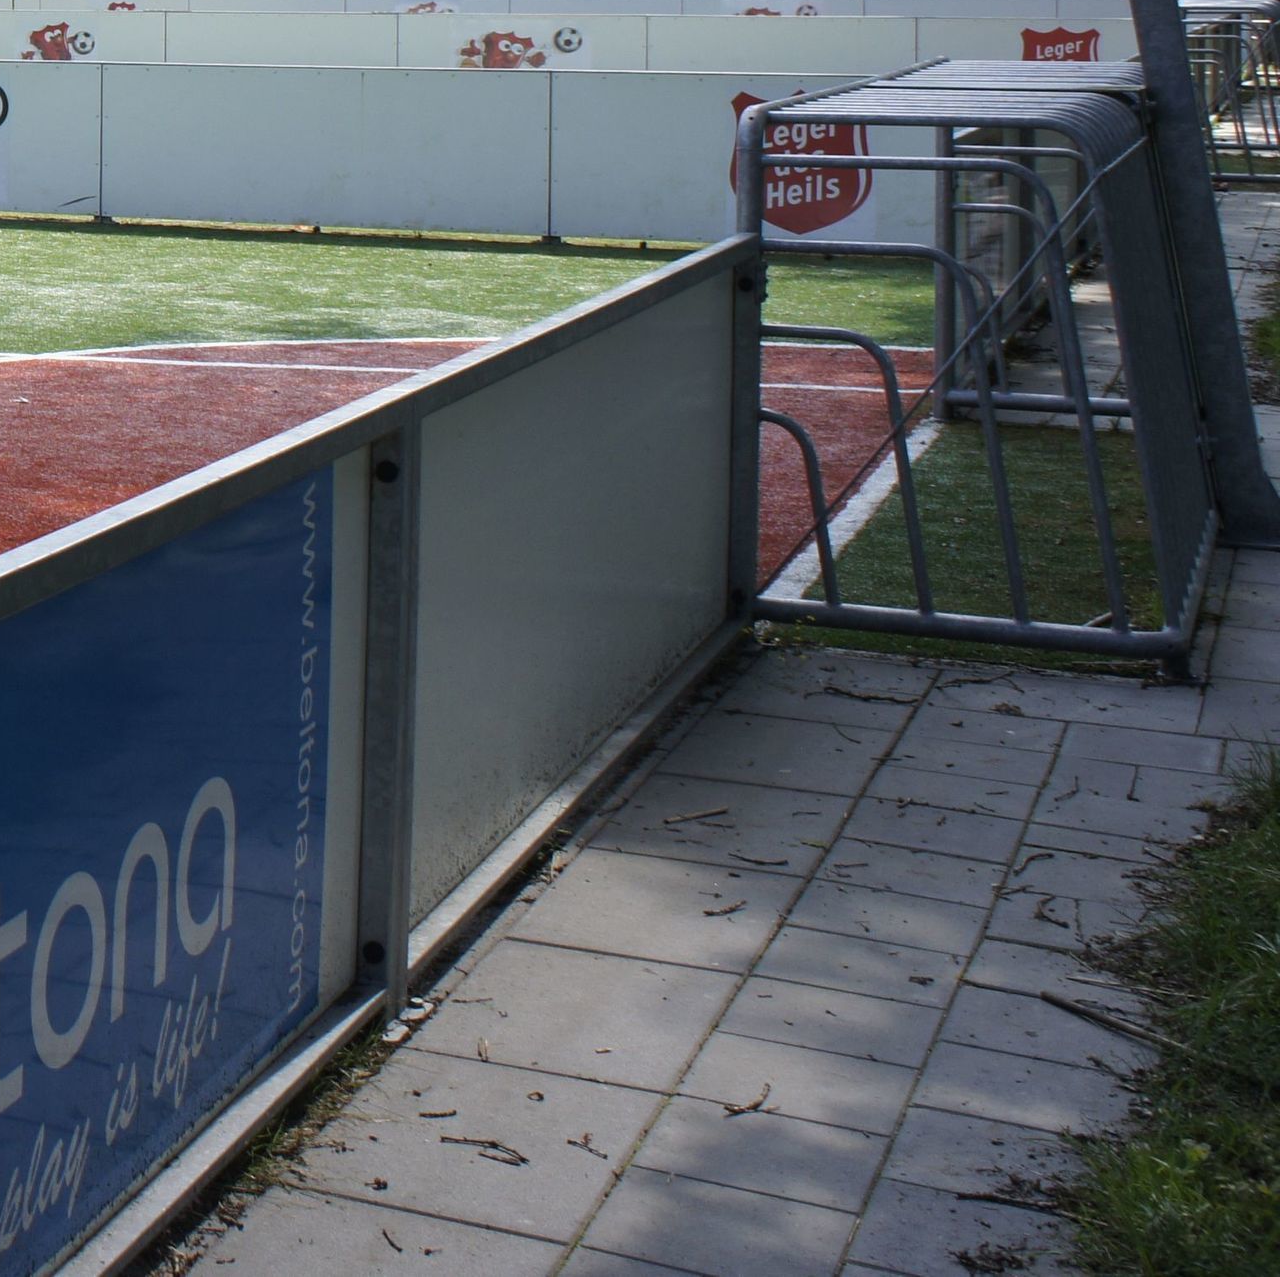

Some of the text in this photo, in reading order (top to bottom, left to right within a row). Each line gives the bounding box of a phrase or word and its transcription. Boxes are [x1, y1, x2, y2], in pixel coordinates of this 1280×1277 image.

[1036, 41, 1083, 59] Leger
[766, 174, 840, 209] Heils
[288, 481, 317, 1014] www.beltona.com
[105, 1062, 138, 1146] is
[152, 937, 231, 1109] life!
